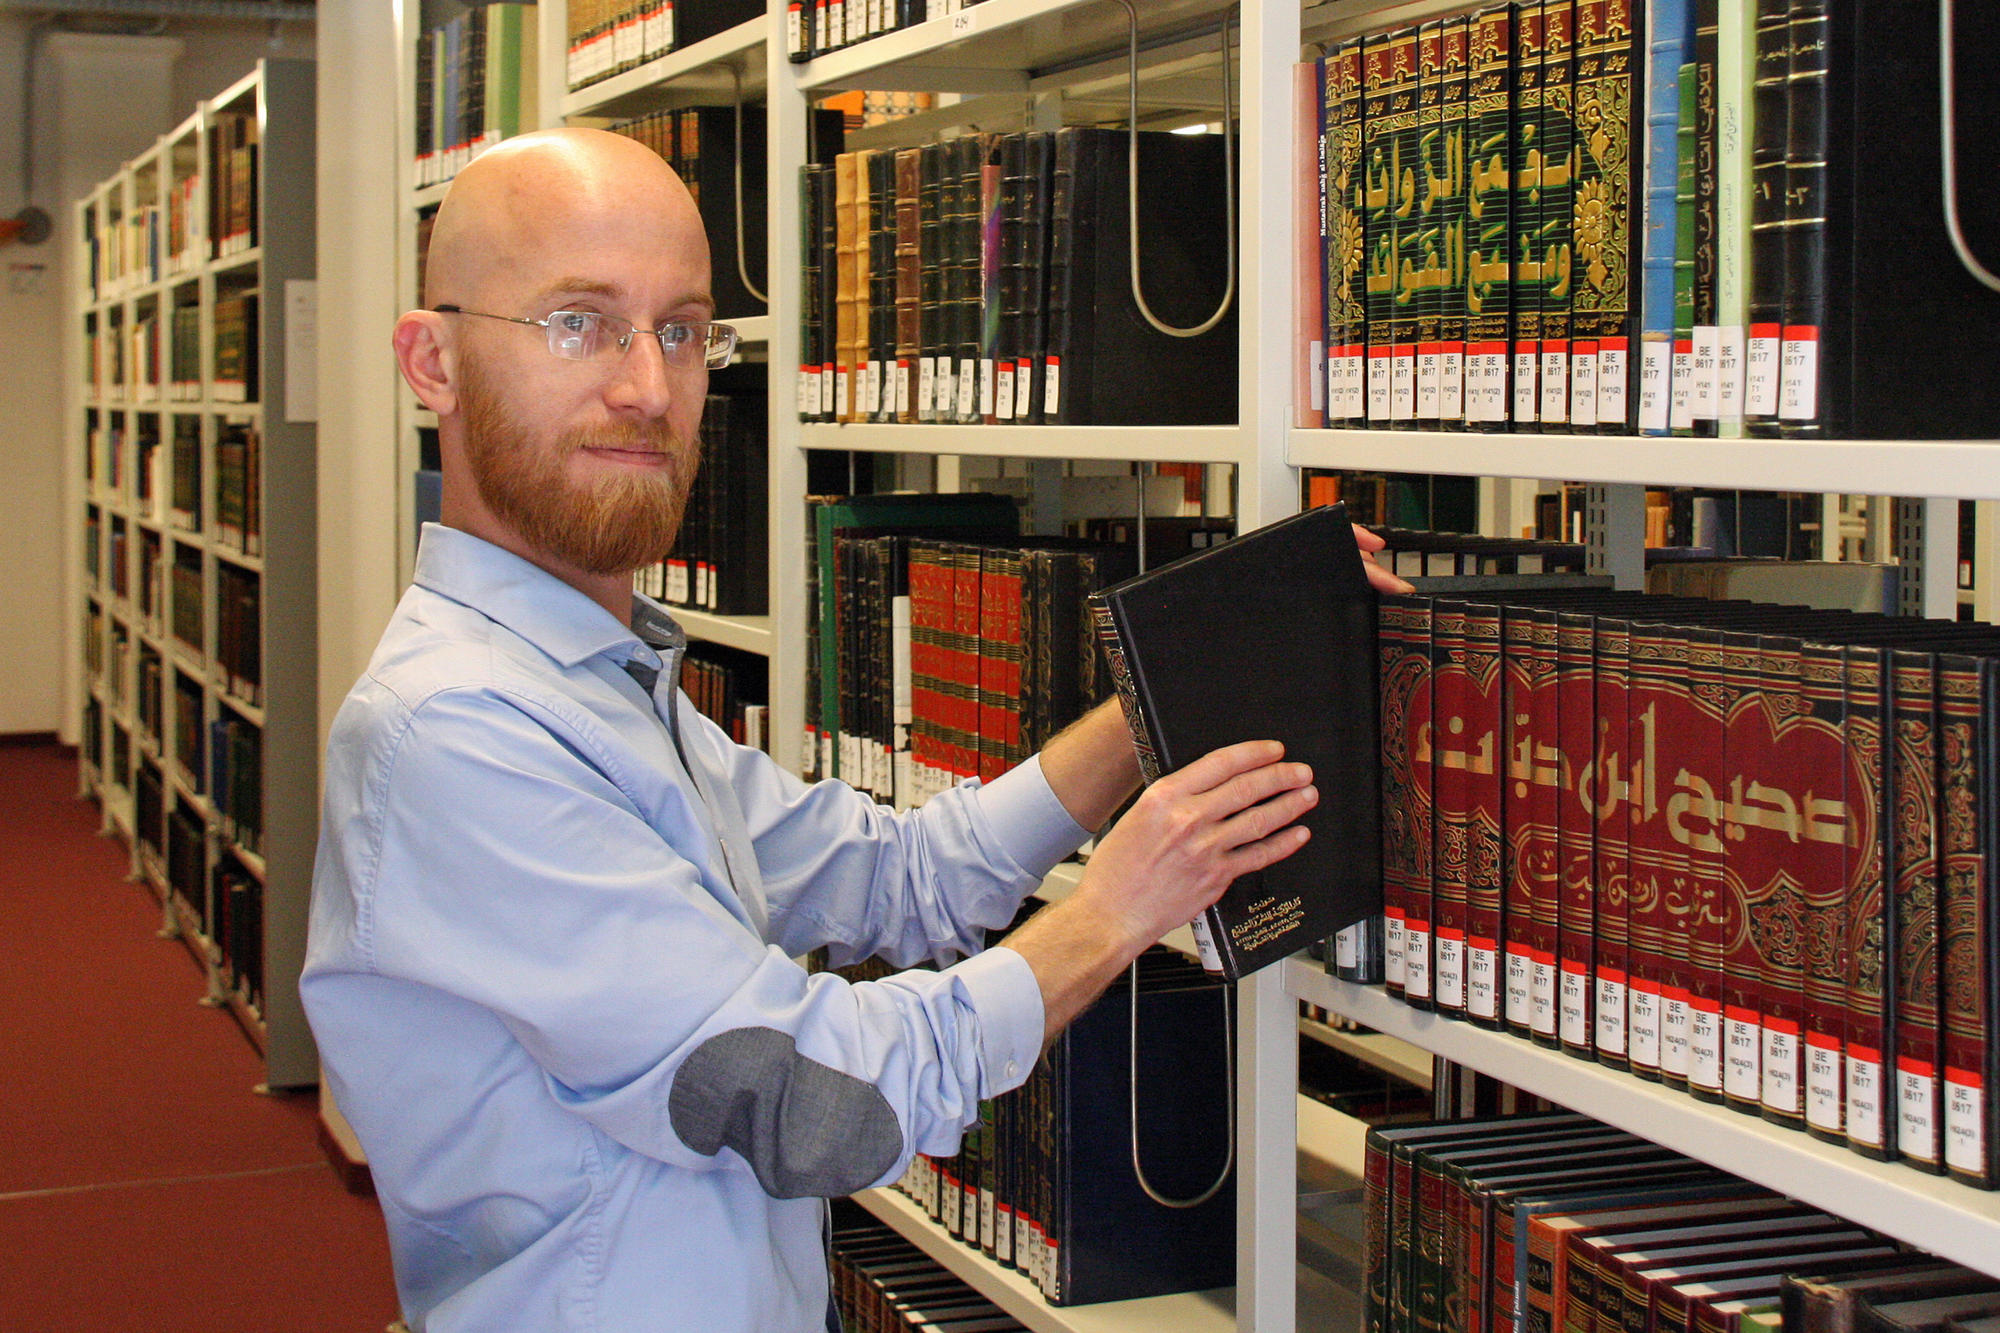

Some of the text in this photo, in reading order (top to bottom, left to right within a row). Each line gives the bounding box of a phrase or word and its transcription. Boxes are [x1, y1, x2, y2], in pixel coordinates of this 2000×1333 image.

[1752, 340, 1765, 350] BE
[1787, 342, 1800, 353] BE
[1699, 346, 1711, 356] BE
[1721, 346, 1732, 356] BE
[1645, 357, 1655, 367] BE
[1675, 356, 1687, 366] BE
[1390, 920, 1399, 930] BE
[1410, 932, 1419, 942] BE
[1442, 941, 1453, 951] BE
[1474, 951, 1485, 961] BE
[1511, 956, 1521, 967] BE
[1535, 965, 1545, 976] BE
[1566, 975, 1575, 986] BE
[1604, 982, 1615, 994] BE
[1637, 993, 1648, 1005] BE
[1669, 1001, 1681, 1013] BE
[1696, 1012, 1708, 1024] BE
[1734, 1023, 1747, 1035] BE
[1773, 1034, 1785, 1046] BE
[1815, 1050, 1828, 1063] BE
[1854, 1062, 1867, 1075] BE
[1906, 1076, 1919, 1089] BE
[1954, 1087, 1968, 1100] BE
